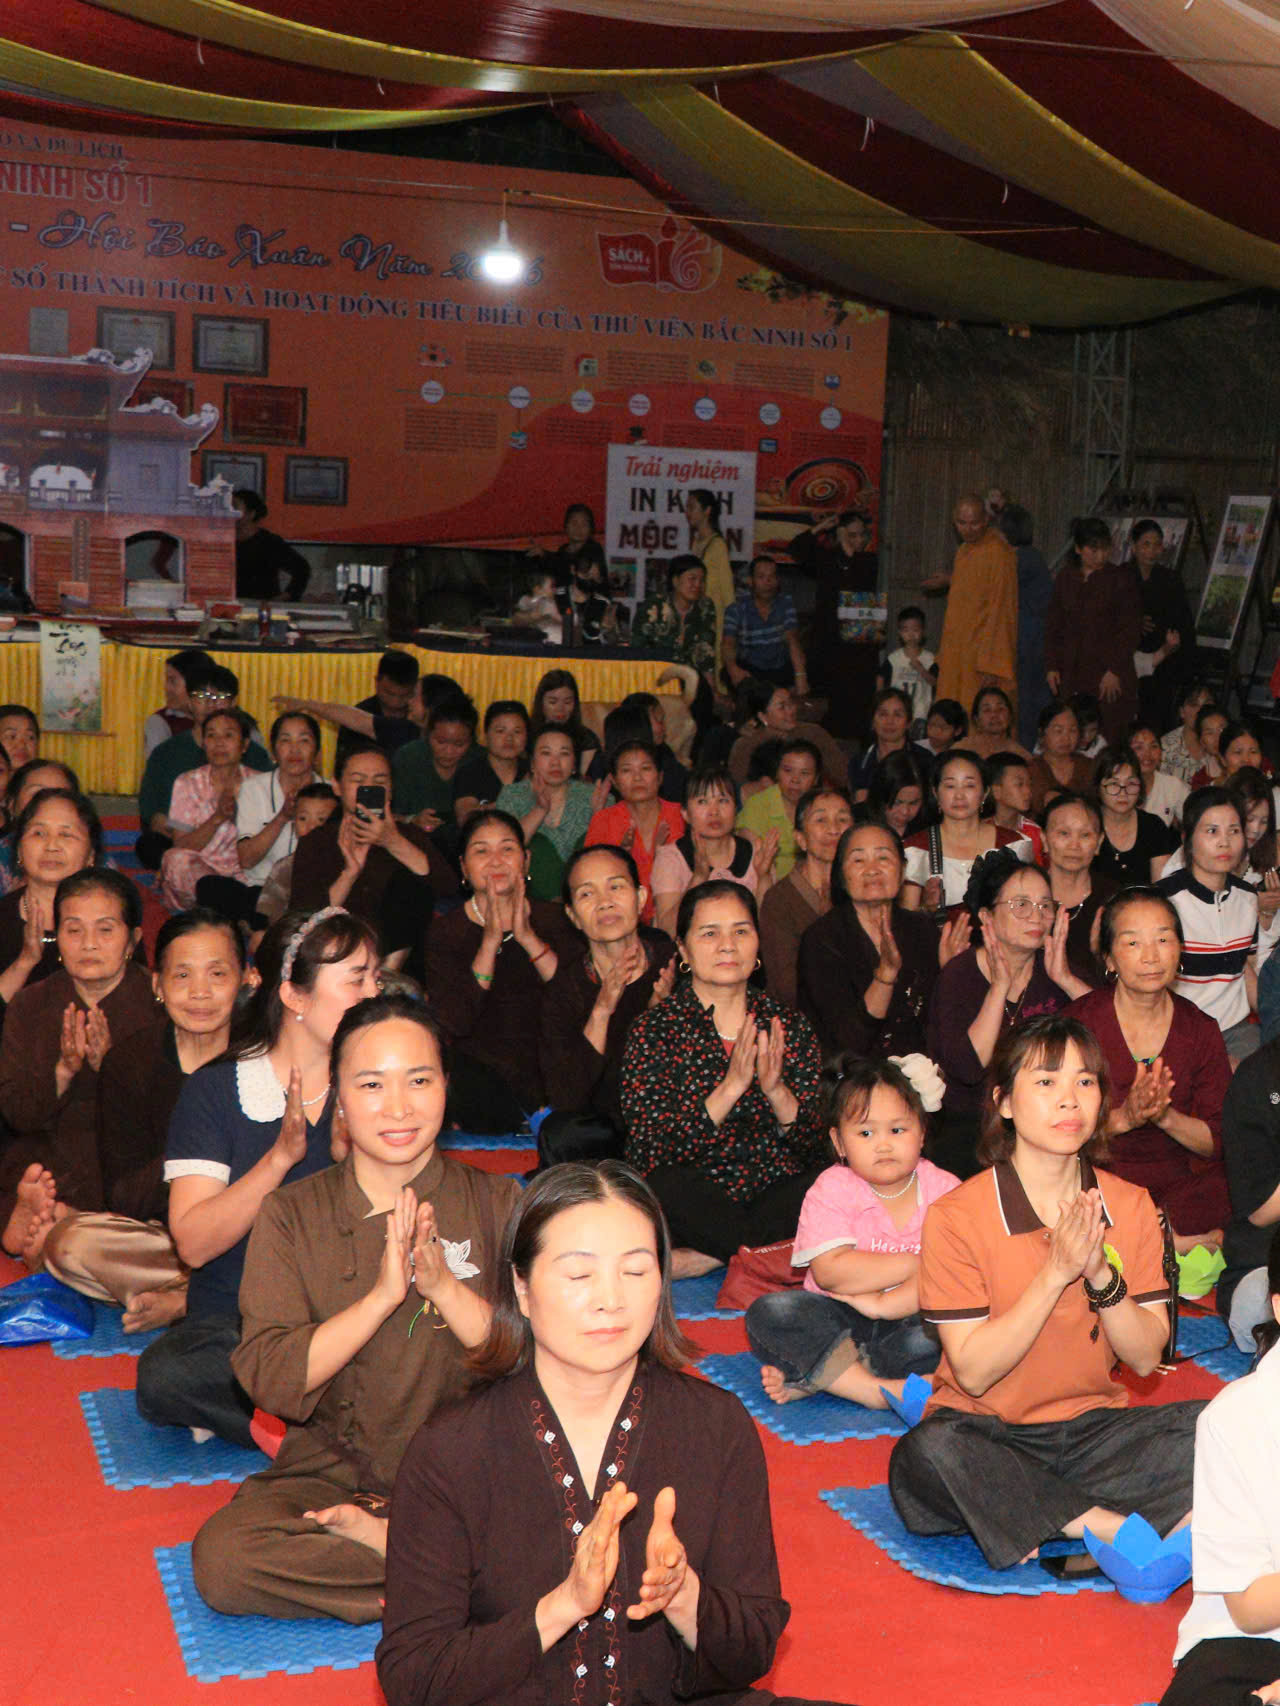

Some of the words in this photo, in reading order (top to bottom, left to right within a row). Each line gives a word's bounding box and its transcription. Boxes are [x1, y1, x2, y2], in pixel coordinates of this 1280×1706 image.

[84, 159, 129, 205] SỐ
[135, 174, 153, 207] 1
[440, 251, 545, 286] 206
[55, 269, 146, 298] THÀNH
[152, 277, 216, 303] TÍCH
[223, 283, 257, 308] VÀ
[262, 287, 334, 316] HOẠT
[338, 291, 409, 320] ĐỘNG
[416, 298, 470, 323] TIÊU
[476, 299, 531, 327] BIỂU
[537, 305, 585, 332] CỦA
[590, 312, 639, 335] THƯ
[643, 315, 697, 340] VIỆN
[702, 314, 746, 344] BẮC
[751, 327, 805, 348] NINH
[809, 326, 838, 351] SỐ
[625, 455, 663, 477] Trải
[666, 458, 741, 484] nghiệm
[630, 487, 656, 512] IN
[667, 488, 734, 515] KH
[618, 518, 679, 556] MỘC
